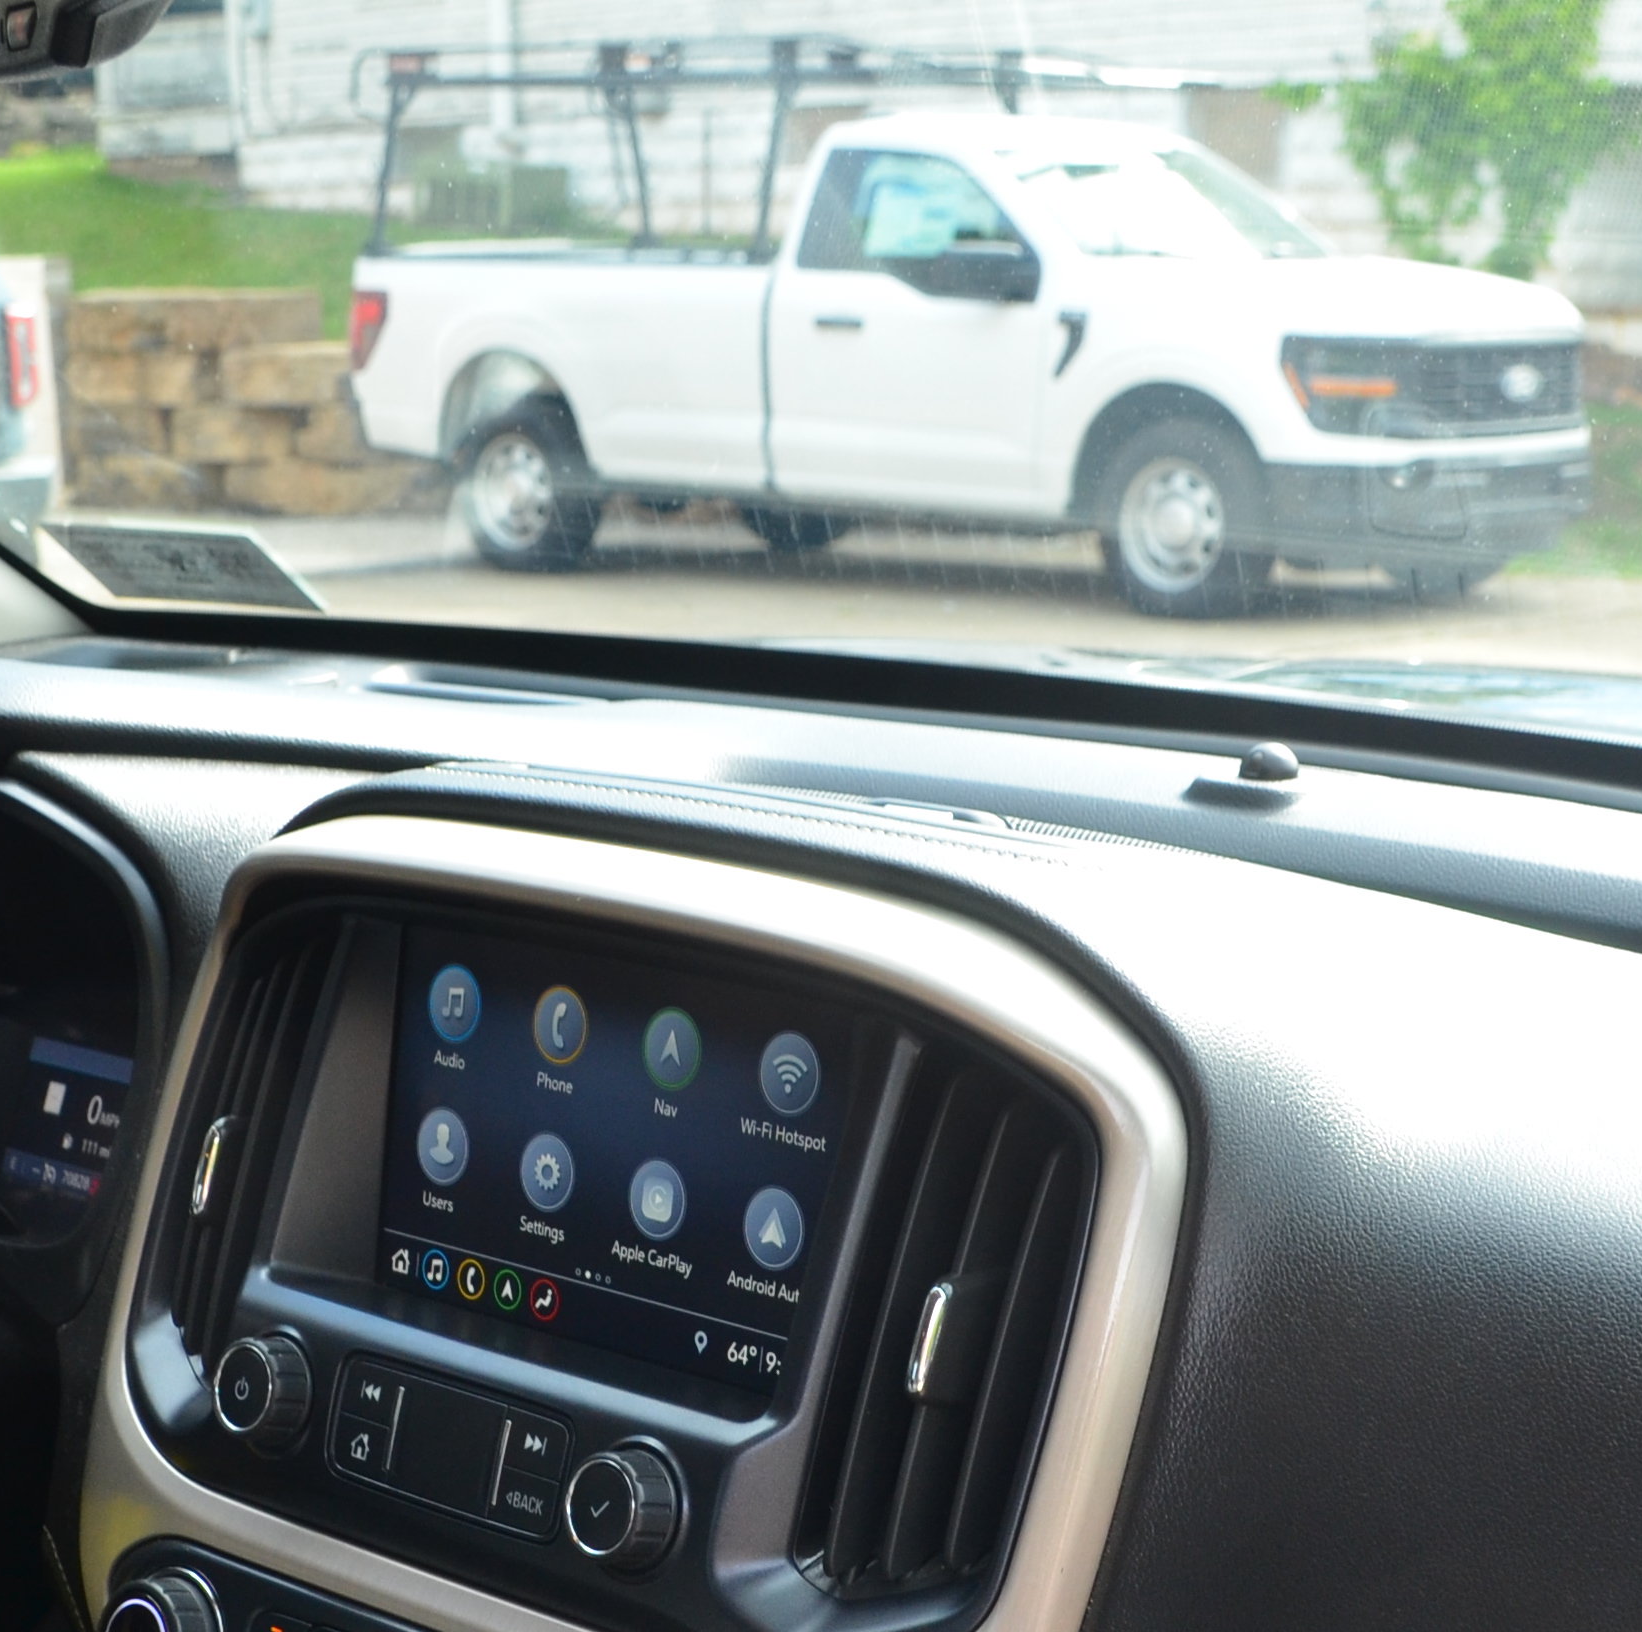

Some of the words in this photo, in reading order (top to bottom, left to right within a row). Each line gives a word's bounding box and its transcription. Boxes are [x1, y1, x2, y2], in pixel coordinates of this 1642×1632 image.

[434, 1050, 465, 1070] Audio
[537, 1072, 573, 1094] Phone
[87, 1096, 102, 1125] 0
[655, 1099, 678, 1119] Nav
[740, 1118, 772, 1140] Wi-Fi
[775, 1125, 826, 1152] Hotspot
[423, 1192, 454, 1213] Users
[520, 1217, 565, 1244] Settings
[611, 1241, 645, 1265] Apple
[648, 1251, 692, 1279] CarPlay
[727, 1272, 775, 1297] Android
[513, 1491, 544, 1516] BACK
